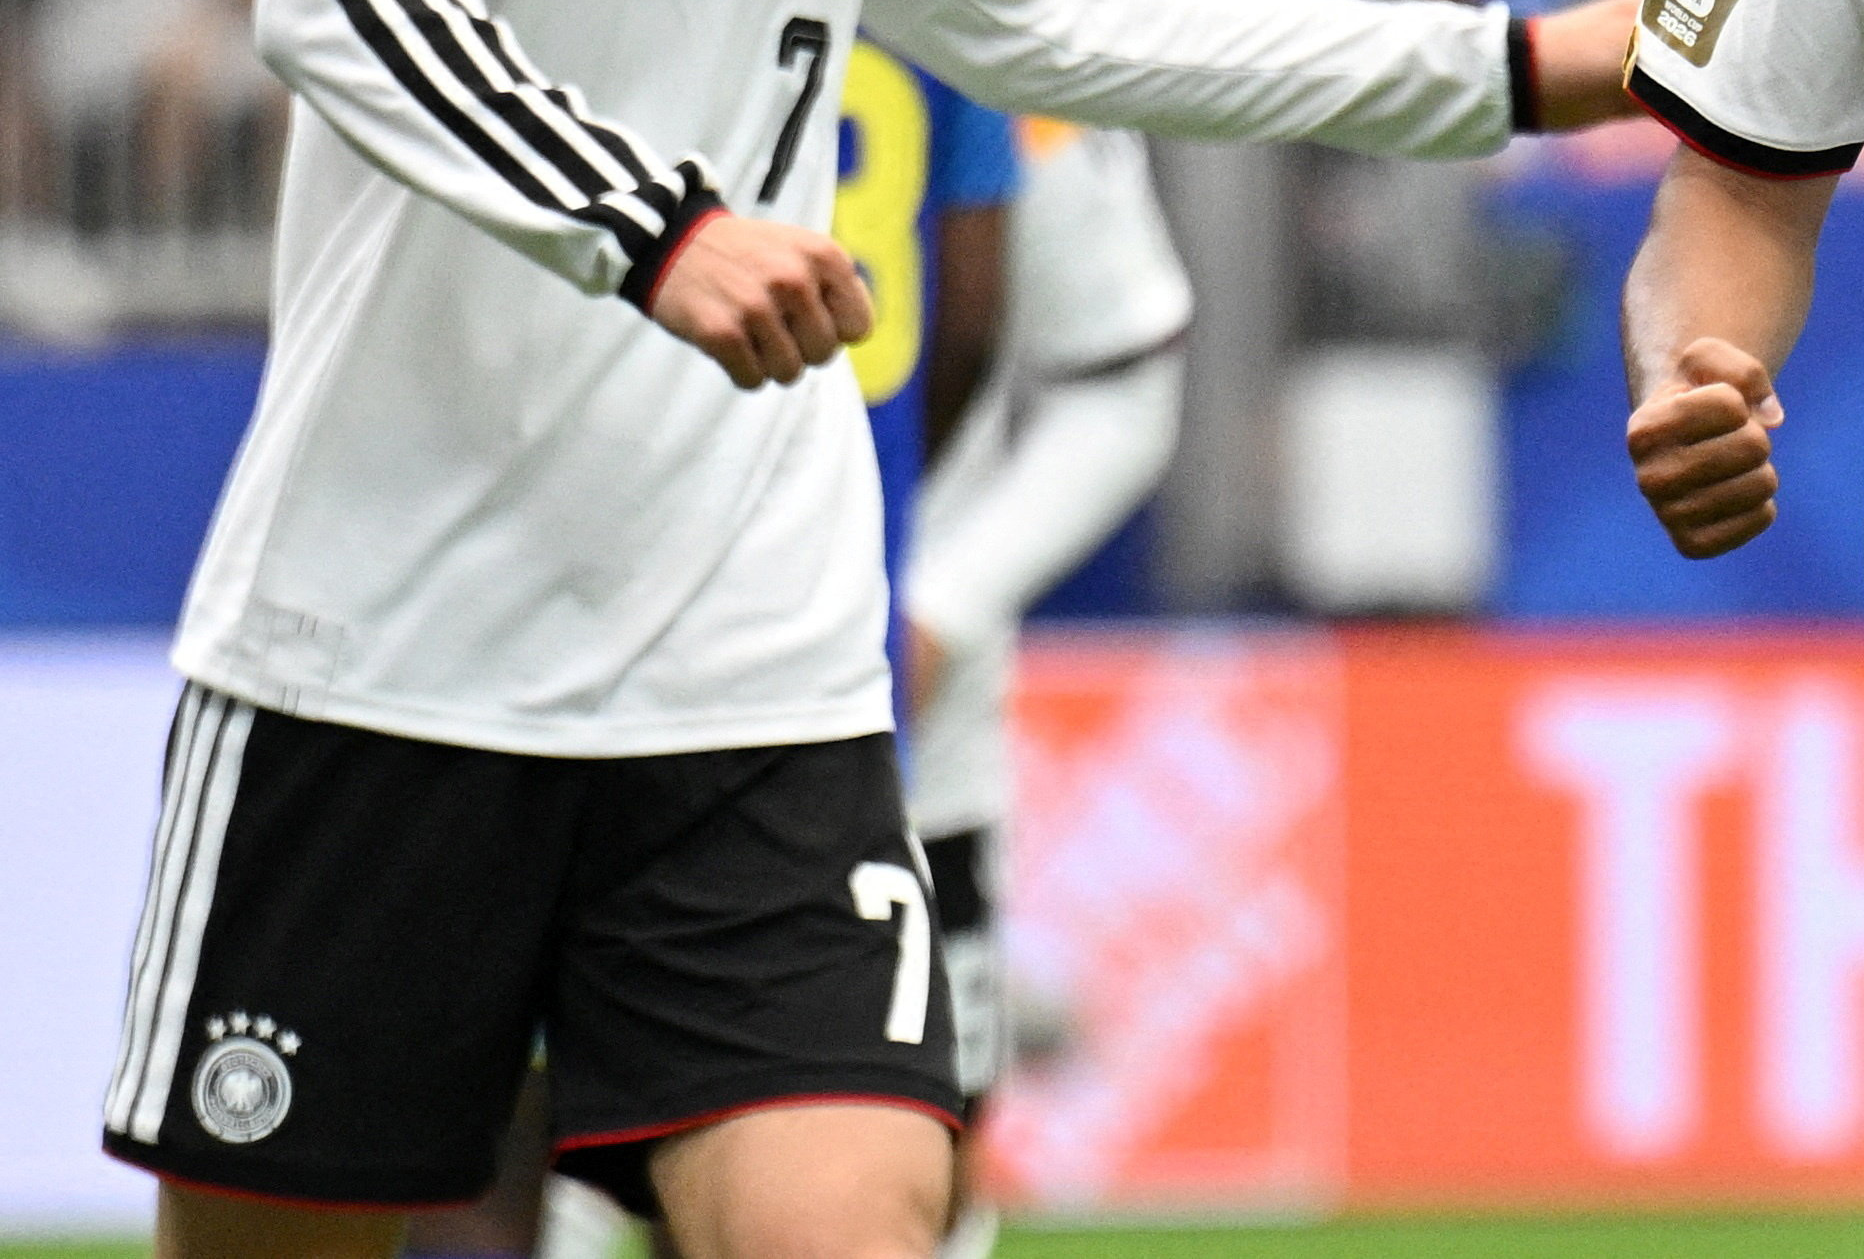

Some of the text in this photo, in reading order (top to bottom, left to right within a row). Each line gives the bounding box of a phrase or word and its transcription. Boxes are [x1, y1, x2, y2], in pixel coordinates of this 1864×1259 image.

[757, 17, 831, 205] 7
[1657, 10, 1698, 48] 2026
[848, 860, 931, 1045] 7
